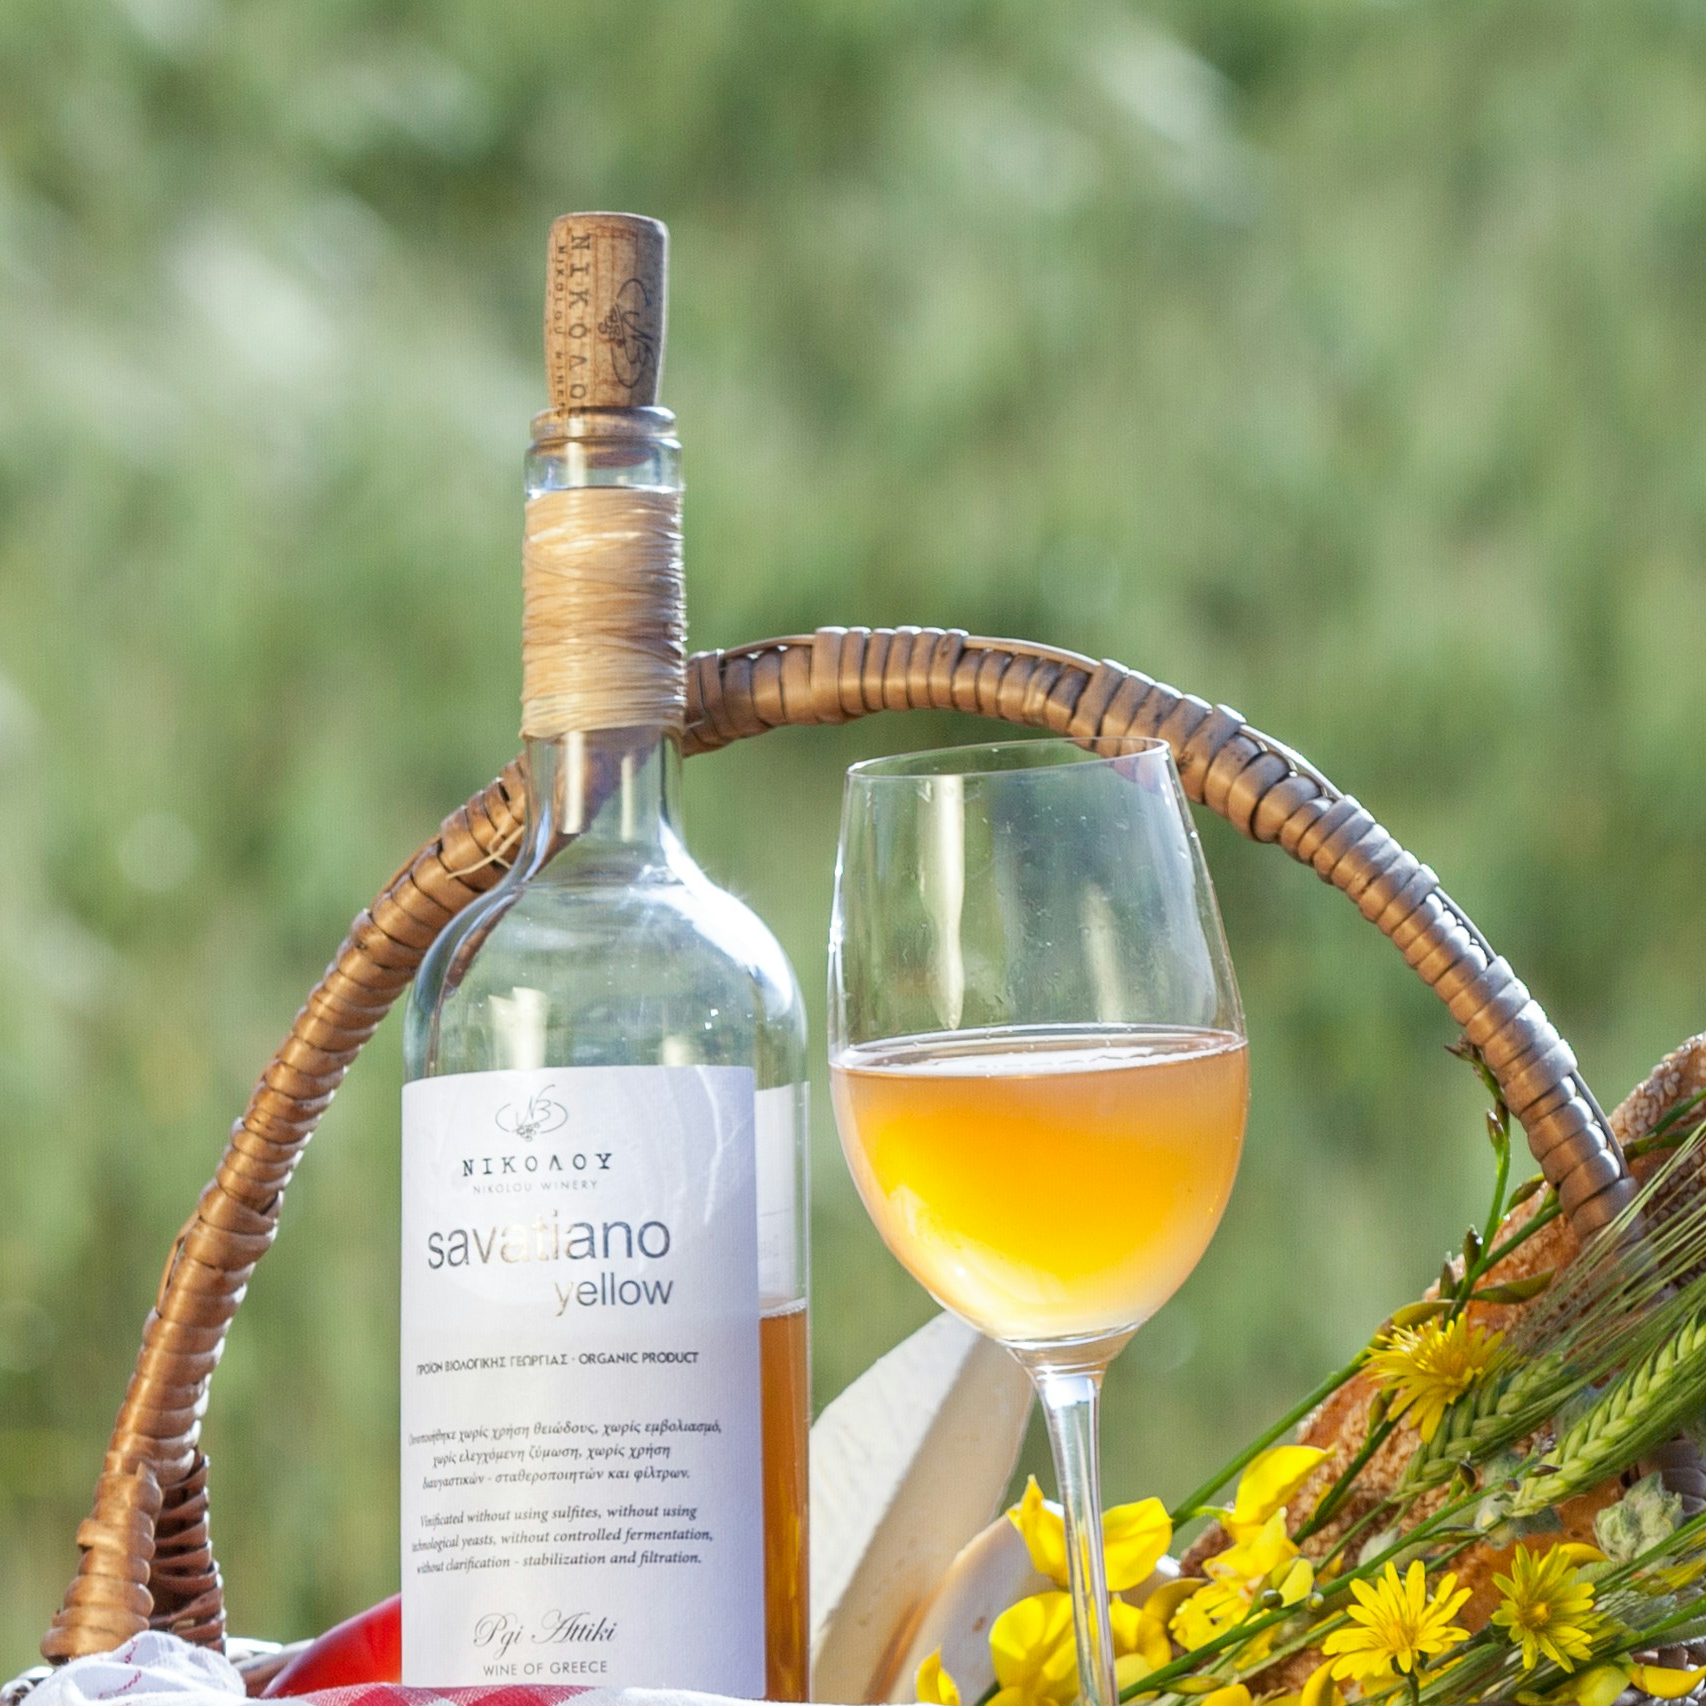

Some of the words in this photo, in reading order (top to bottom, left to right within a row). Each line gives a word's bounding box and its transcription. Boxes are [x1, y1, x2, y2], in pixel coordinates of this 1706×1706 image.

[554, 245, 565, 335] NIKOLOU
[568, 234, 590, 412] ΝΙΚΟΛΟ
[472, 1183, 532, 1194] NIKOLOU
[541, 1180, 598, 1191] WINERY
[427, 1209, 670, 1270] savatiano
[555, 1273, 674, 1317] yellow
[578, 1352, 639, 1365] ORGANIC
[642, 1351, 699, 1364] PRODUCT
[467, 1508, 511, 1525] without
[514, 1508, 549, 1523] using
[551, 1505, 603, 1523] sulfites,
[606, 1504, 660, 1519] without
[662, 1504, 698, 1521] using
[461, 1533, 497, 1551] yeasts,
[501, 1530, 550, 1544] without
[553, 1527, 622, 1543] controlled
[622, 1527, 714, 1545] fermentation,
[445, 1555, 511, 1575] clarification
[522, 1552, 606, 1567] stabilization
[609, 1550, 636, 1564] and
[637, 1550, 703, 1568] filtration.
[531, 1609, 619, 1643] Attiki
[483, 1663, 518, 1676] WINE
[523, 1662, 544, 1675] OF
[549, 1660, 608, 1674] GREECE
